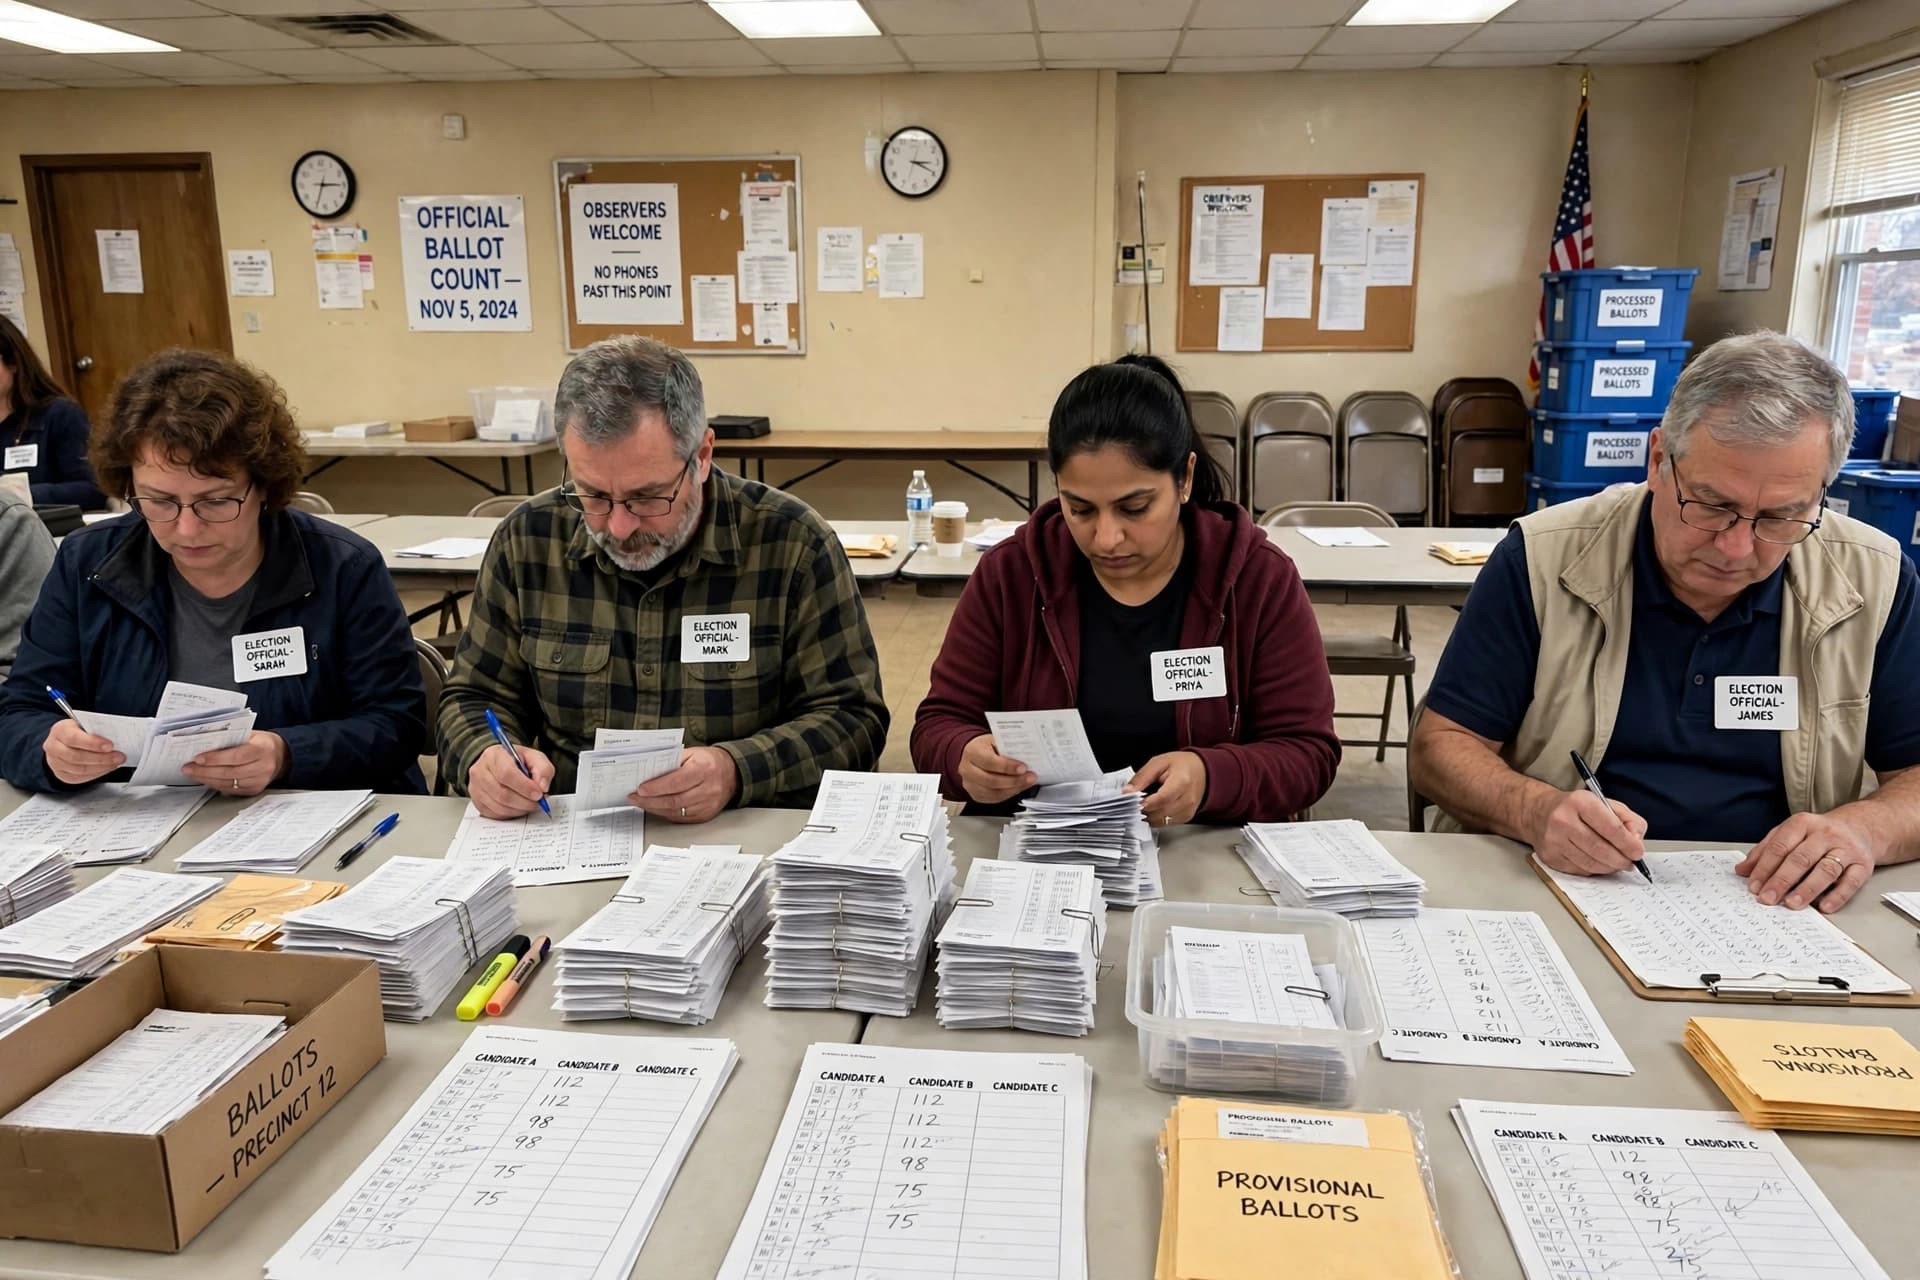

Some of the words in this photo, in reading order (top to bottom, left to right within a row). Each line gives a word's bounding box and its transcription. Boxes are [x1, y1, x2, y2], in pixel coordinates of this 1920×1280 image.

[583, 202, 667, 219] OBSERVERS
[417, 206, 510, 229] OFFICIAL
[589, 224, 662, 240] WELCOME
[425, 237, 504, 260] BALLOT
[594, 266, 612, 279] NO
[614, 266, 658, 279] PHONES
[583, 285, 609, 298] PAST
[611, 285, 637, 298] THIS
[639, 285, 672, 298] POINT
[1605, 296, 1656, 305] PROCESSED
[420, 300, 455, 319] NOV
[460, 300, 474, 322] 5,
[479, 300, 518, 319] 2024
[1610, 309, 1648, 318] BALLOTS
[1600, 367, 1649, 376] PROCESSED
[1604, 380, 1640, 388] BALLOTS
[1592, 438, 1641, 448] PROCESSED
[1597, 450, 1634, 459] BALLOTS
[694, 620, 738, 632] ELECTION
[244, 636, 290, 650] ELECTION
[702, 645, 728, 655] MARK
[254, 660, 286, 672] SARAH
[1164, 655, 1210, 668] ELECTION
[1728, 684, 1782, 694] ELECTION
[1737, 710, 1774, 720] JAMES
[1484, 1024, 1508, 1032] 112
[475, 1053, 528, 1066] CANDIDATE
[528, 1058, 537, 1066] A
[1773, 1044, 1878, 1062] BALLOTS
[557, 1060, 610, 1072] CANDIDATE
[611, 1064, 620, 1072] B
[635, 1064, 686, 1076] CANDIDATE
[689, 1067, 698, 1076] C
[1762, 1060, 1914, 1080] PROVISIONAL
[553, 1076, 584, 1088] 112
[820, 1072, 876, 1083] CANDIDATE
[878, 1076, 886, 1084] A
[908, 1078, 964, 1088] CANDIDATE
[967, 1080, 974, 1088] B
[227, 1038, 318, 1138] BALLOTS
[993, 1082, 1048, 1092] CANDIDATE
[1051, 1084, 1058, 1092] C
[539, 1094, 570, 1107] 112
[914, 1094, 944, 1106] 112
[232, 1086, 311, 1178] PRECINCT
[318, 1066, 336, 1098] 12
[529, 1115, 554, 1129] 98
[908, 1114, 941, 1126] 112
[1494, 1128, 1556, 1140] CANDIDATE
[1558, 1132, 1568, 1141] A
[1592, 1134, 1653, 1144] CANDIDATE
[1656, 1136, 1665, 1146] B
[514, 1135, 543, 1150] 98
[902, 1137, 933, 1148] 112
[1684, 1138, 1746, 1149] CANDIDATE
[1748, 1142, 1759, 1150] C
[1610, 1150, 1646, 1163] 112
[900, 1156, 928, 1172] 98
[493, 1164, 527, 1179] 75
[895, 1184, 928, 1198] 75
[1217, 1170, 1385, 1200] PROVISIONAL
[473, 1191, 508, 1206] 75
[1241, 1198, 1360, 1222] BALLOTS
[886, 1214, 919, 1230] 75
[1646, 1218, 1680, 1234] 75
